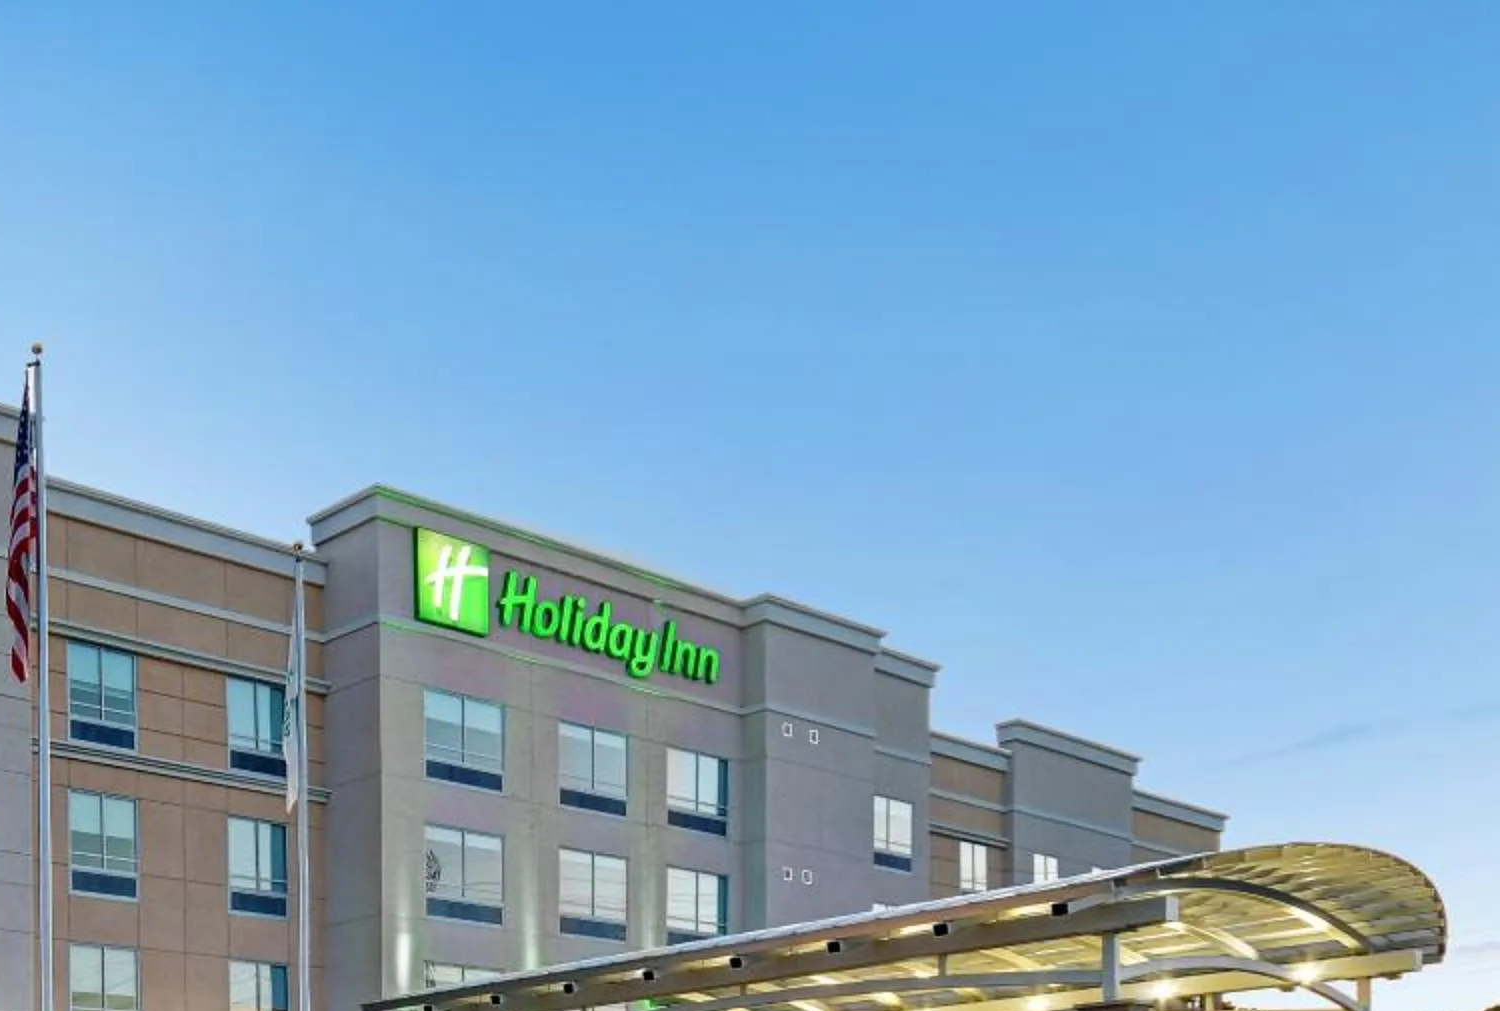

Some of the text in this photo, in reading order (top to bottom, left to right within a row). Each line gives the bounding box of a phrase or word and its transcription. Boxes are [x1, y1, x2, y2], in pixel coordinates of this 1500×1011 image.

[425, 545, 488, 621] H
[498, 570, 719, 683] Holiday Inn
